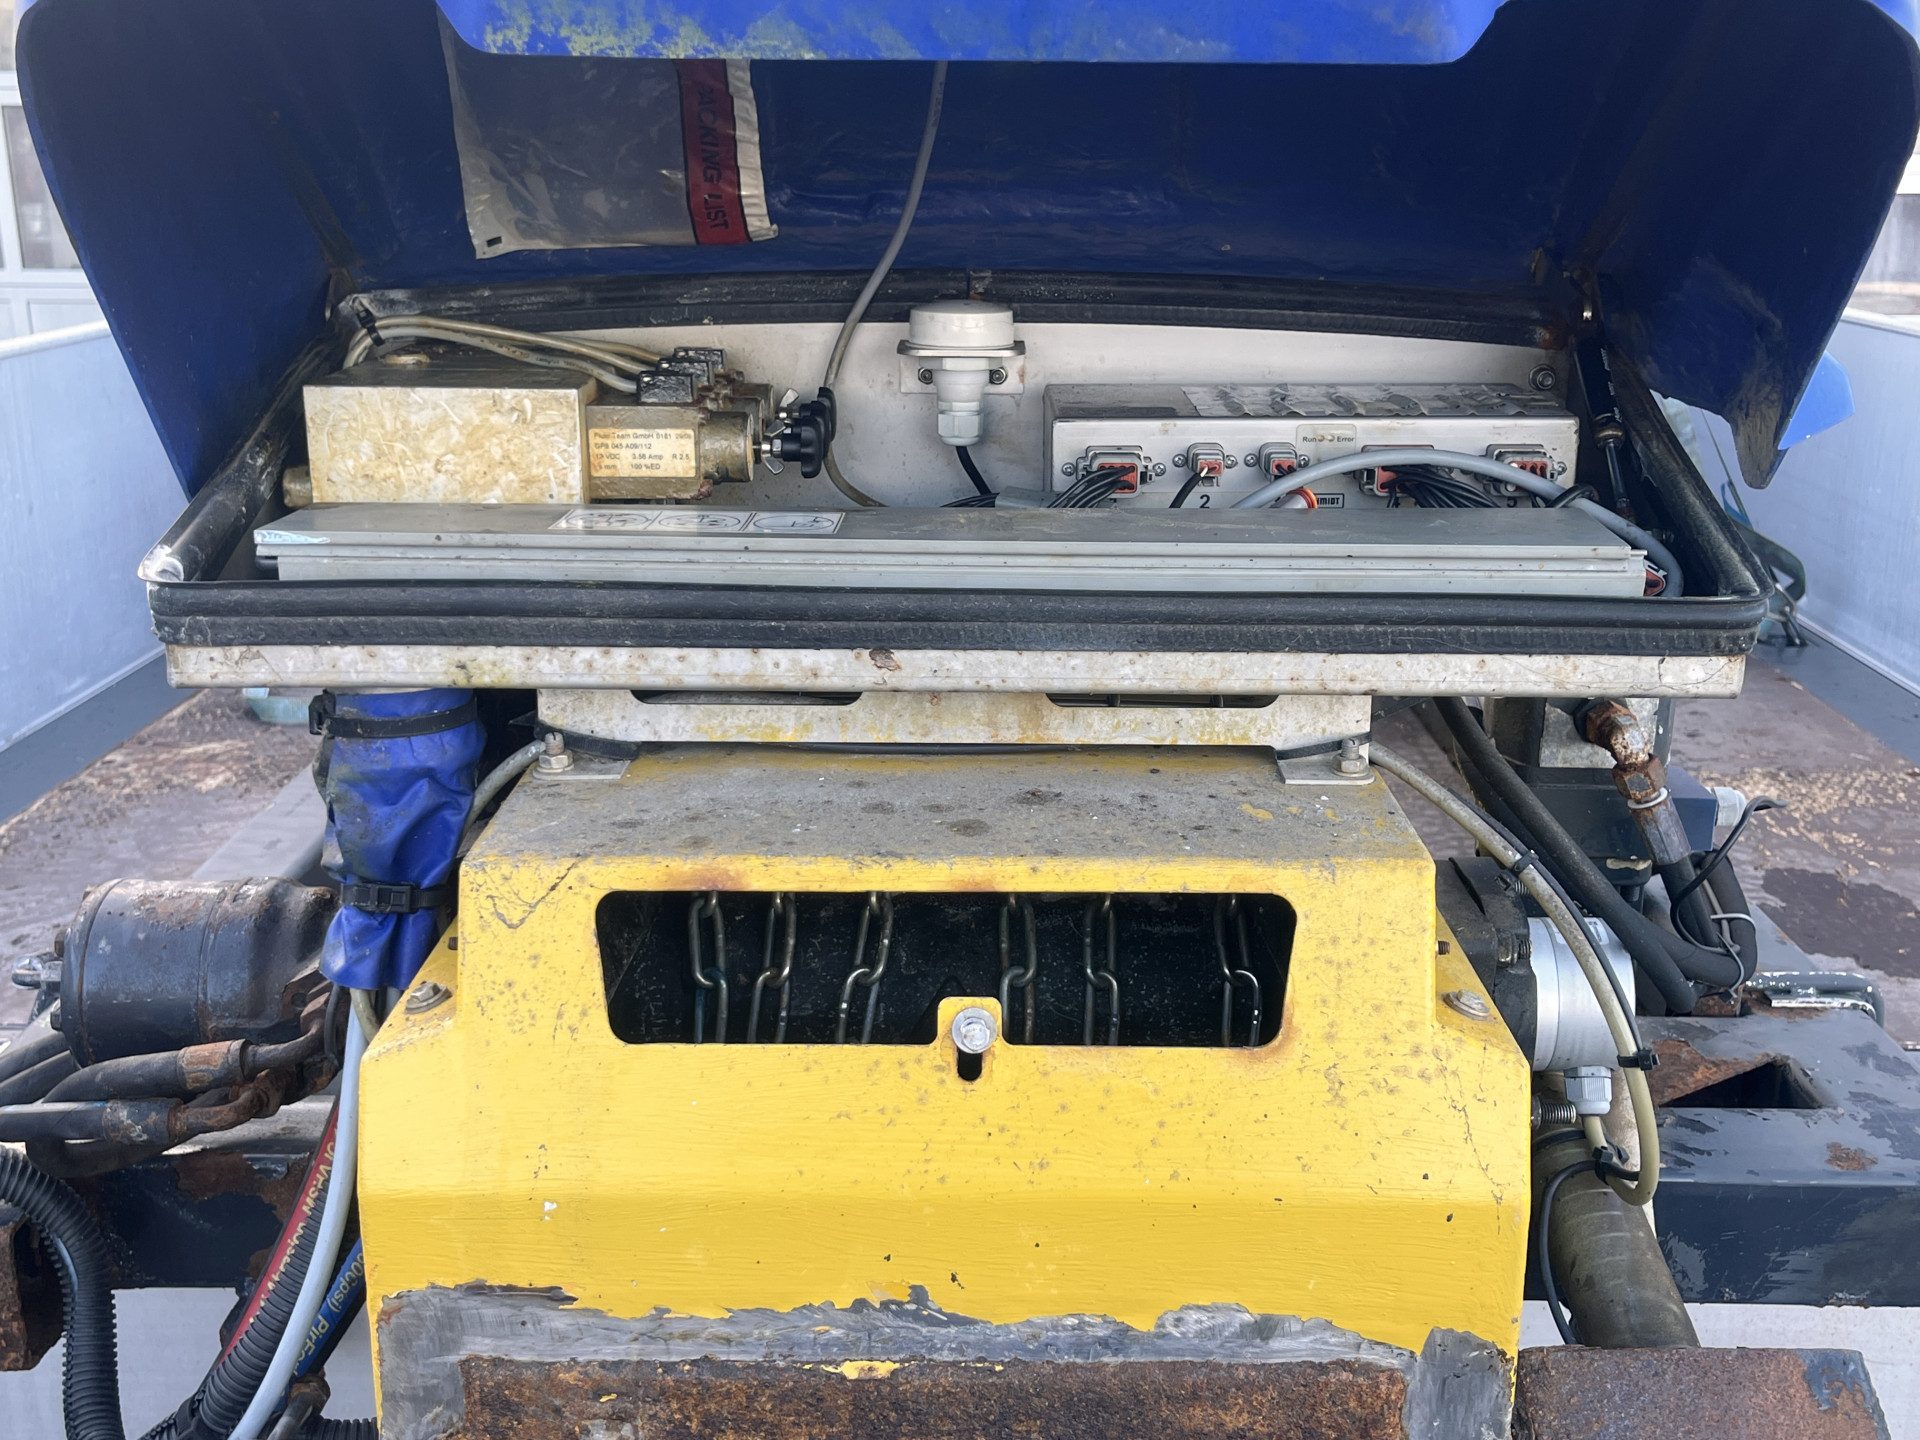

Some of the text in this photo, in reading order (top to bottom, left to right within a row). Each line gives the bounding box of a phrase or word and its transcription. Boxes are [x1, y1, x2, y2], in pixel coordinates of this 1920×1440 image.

[703, 192, 730, 230] LIST
[648, 453, 664, 461] Amp
[1200, 494, 1210, 508] 2
[1317, 497, 1340, 505] MIDT
